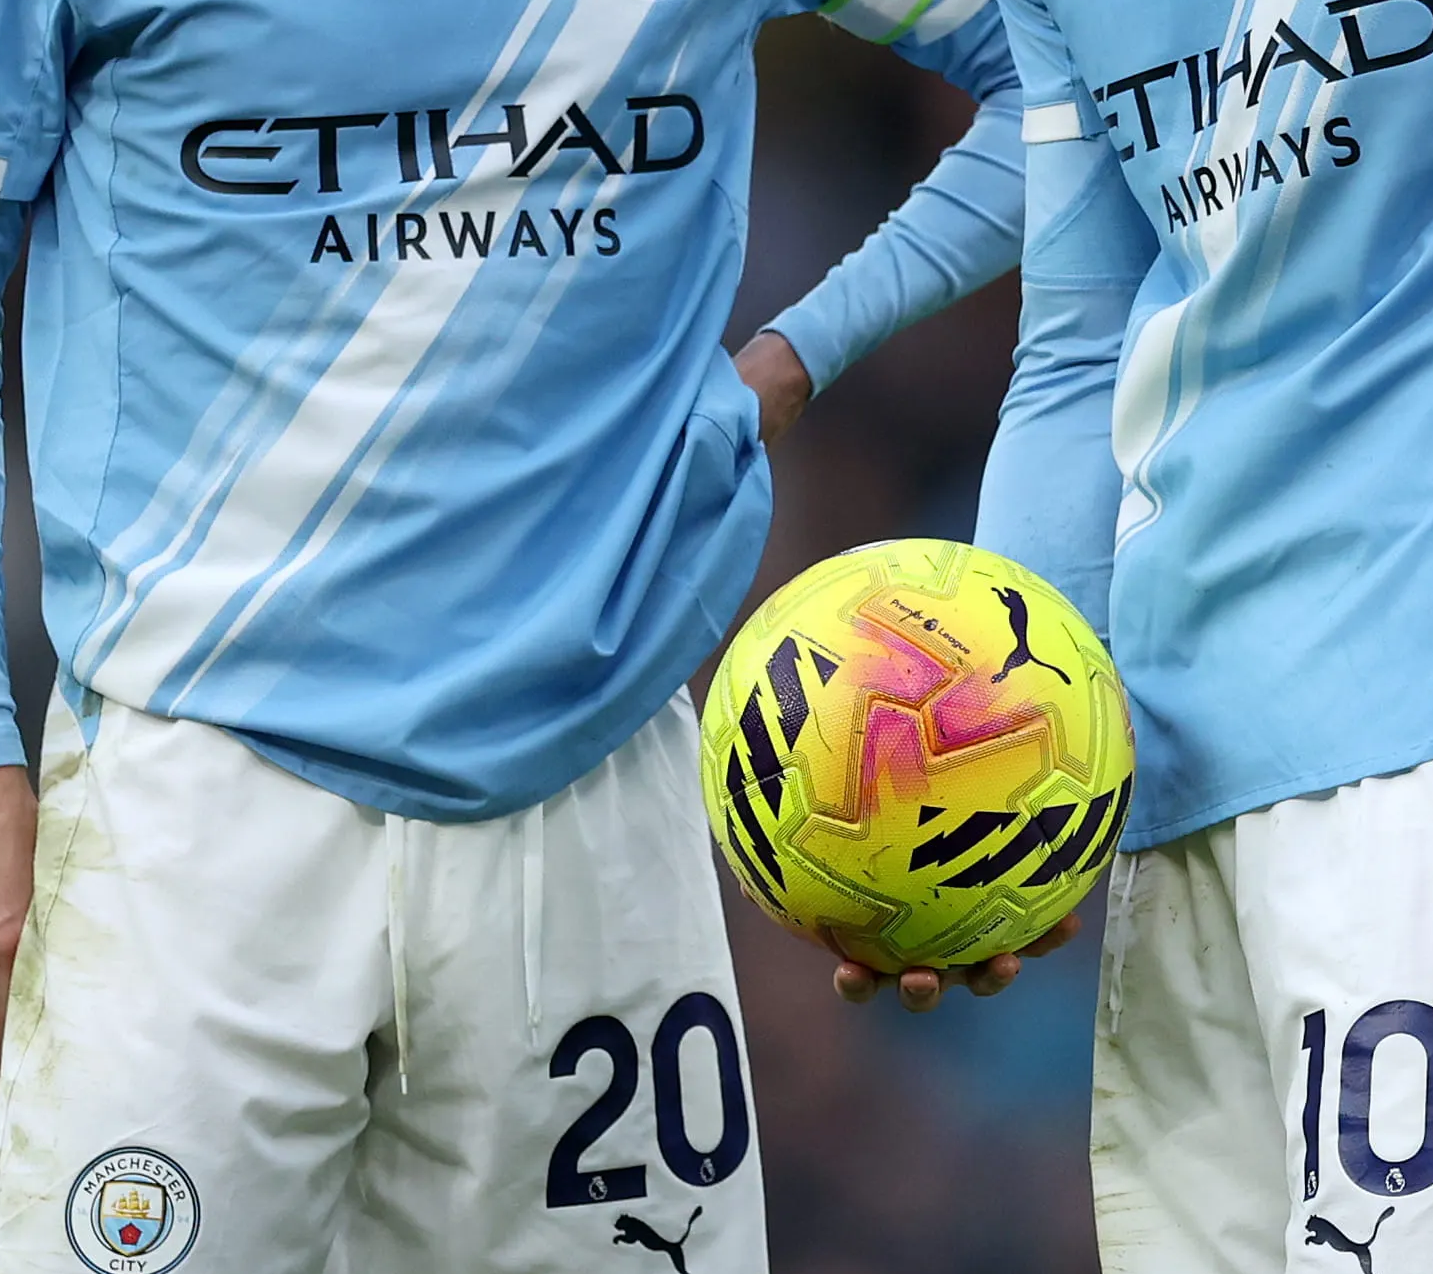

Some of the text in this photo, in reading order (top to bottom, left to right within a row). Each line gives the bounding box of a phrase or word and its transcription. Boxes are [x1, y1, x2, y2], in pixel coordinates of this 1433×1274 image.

[179, 94, 705, 195] ETIHAD
[1160, 116, 1361, 233] AIRWAYS
[310, 208, 622, 264] AIRWAYS
[937, 627, 971, 655] League
[546, 992, 750, 1209] 20
[83, 1157, 186, 1203] MANCHESTER
[109, 1258, 148, 1272] CITY
